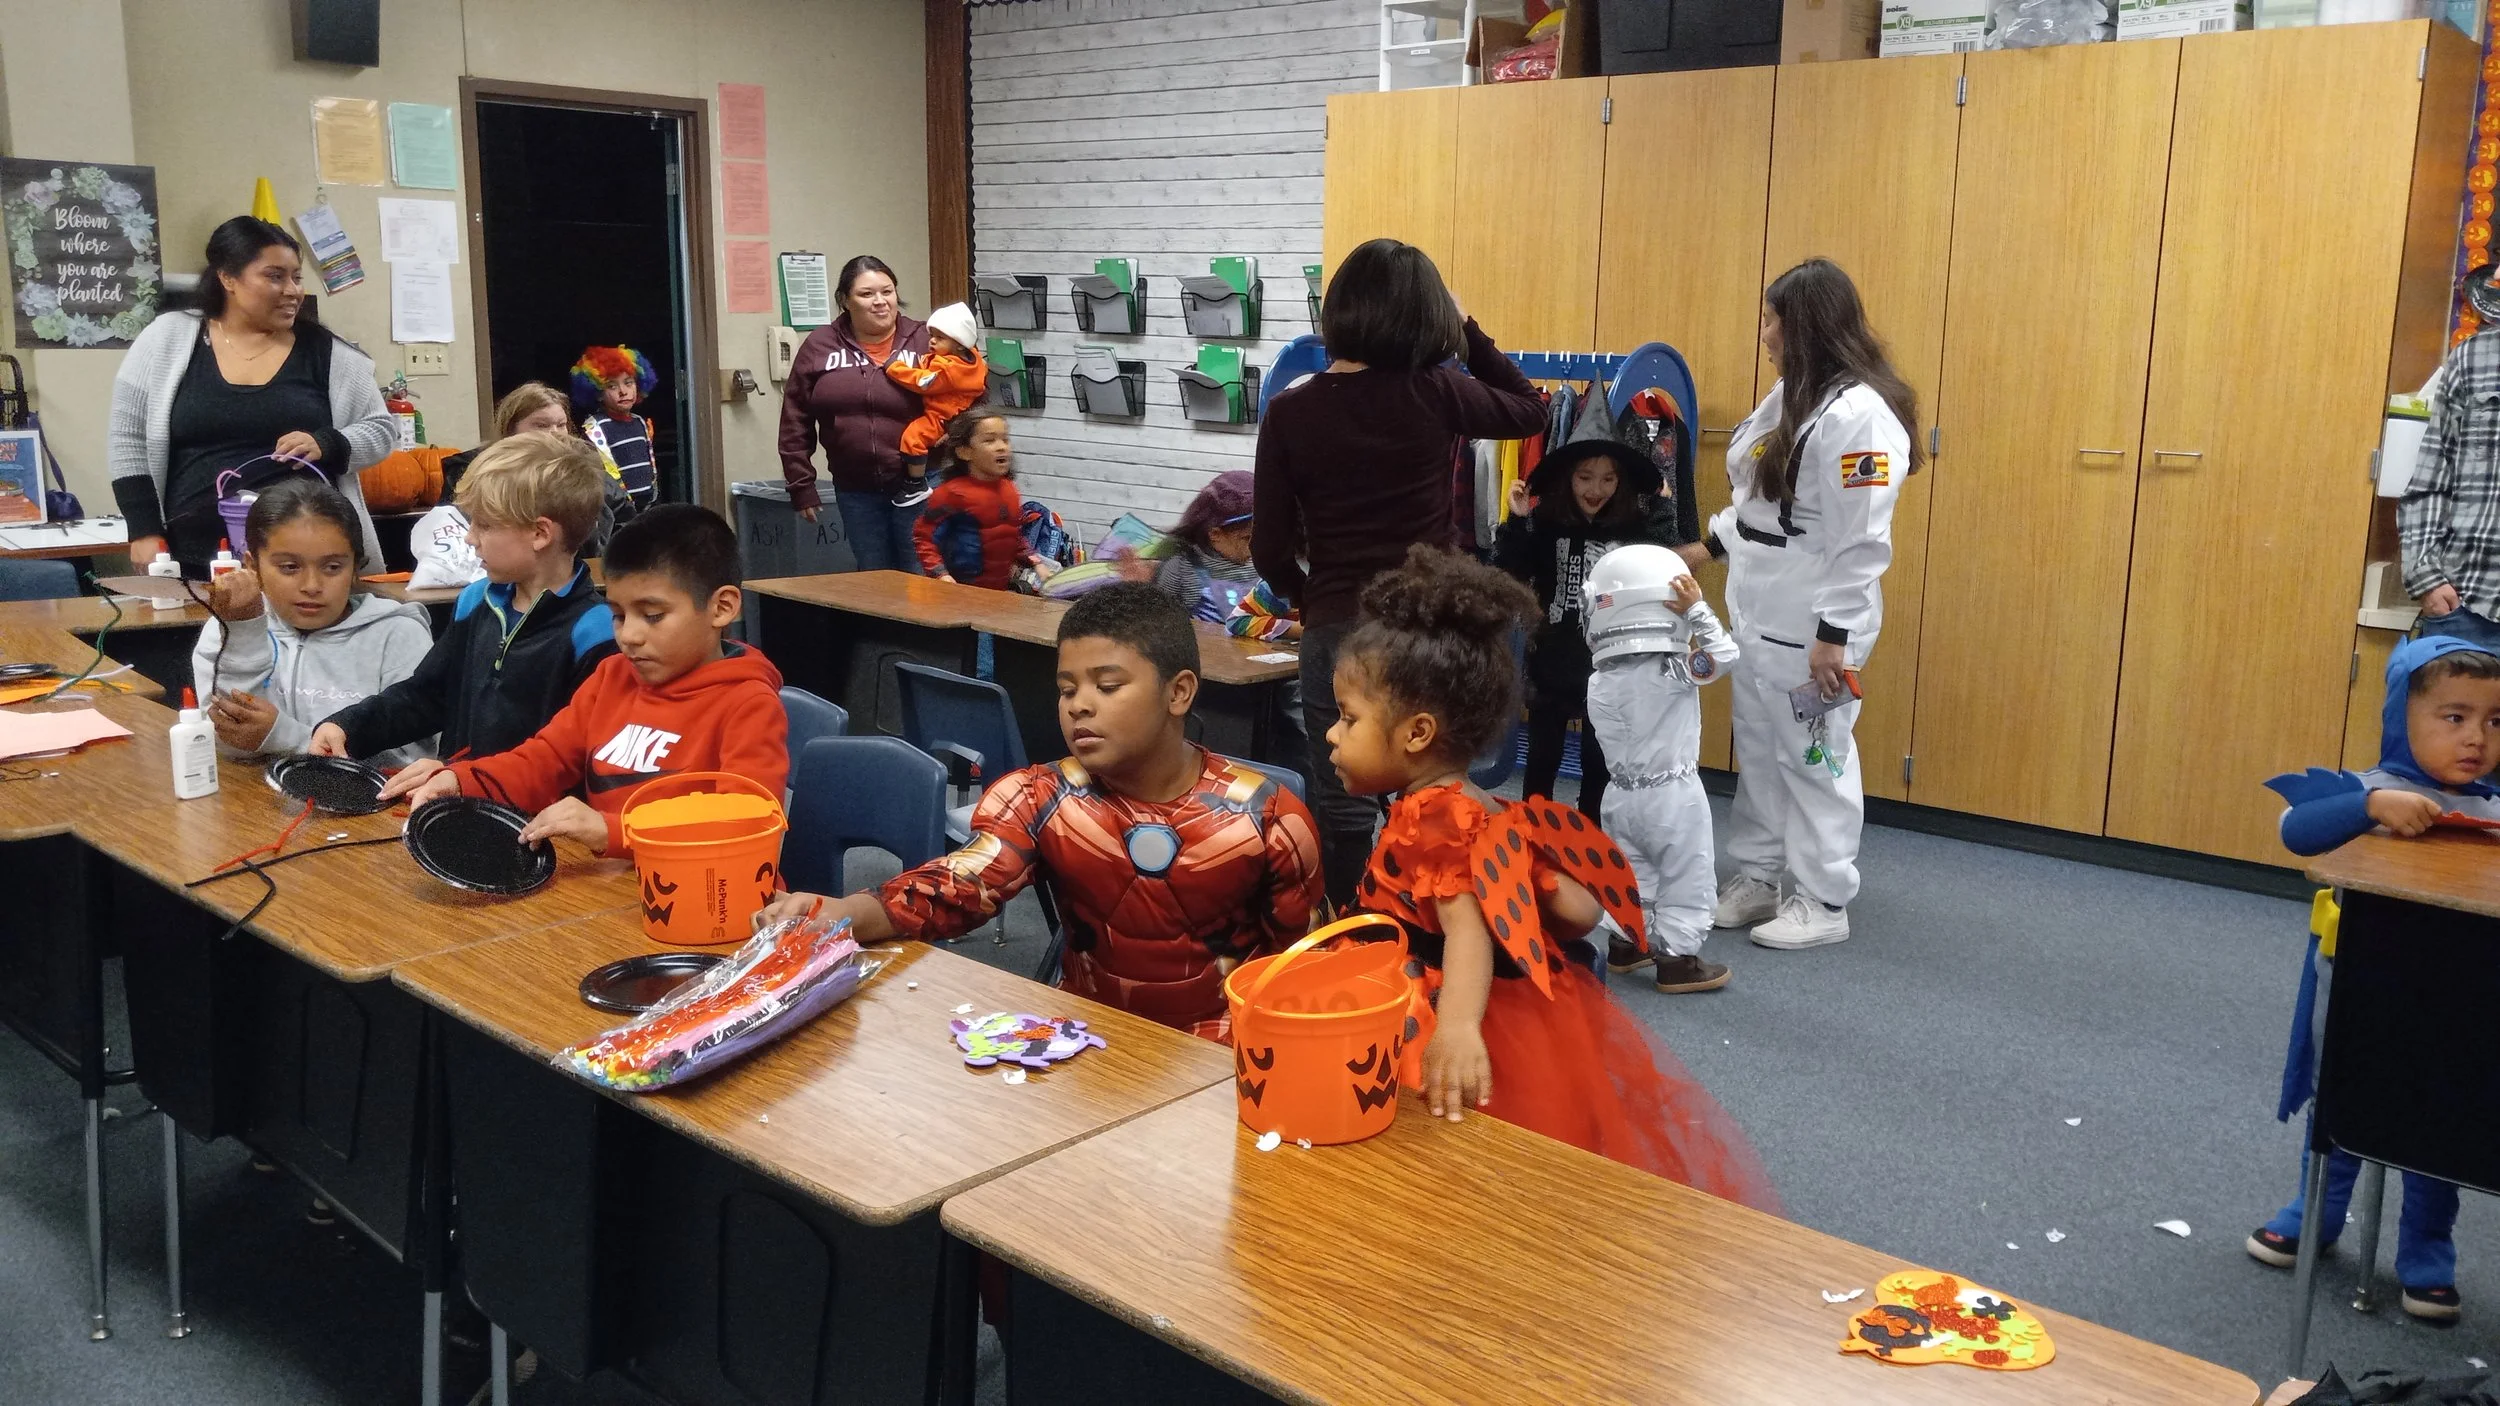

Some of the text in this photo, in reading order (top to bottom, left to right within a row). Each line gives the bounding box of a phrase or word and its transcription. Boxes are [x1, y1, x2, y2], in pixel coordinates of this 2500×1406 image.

[55, 205, 111, 230] Bloom
[60, 232, 110, 255] where
[57, 262, 118, 283] you are
[57, 279, 123, 305] planted
[1565, 555, 1581, 611] TIGERS
[594, 724, 682, 773] NIKE
[718, 878, 728, 924] McPunk'n
